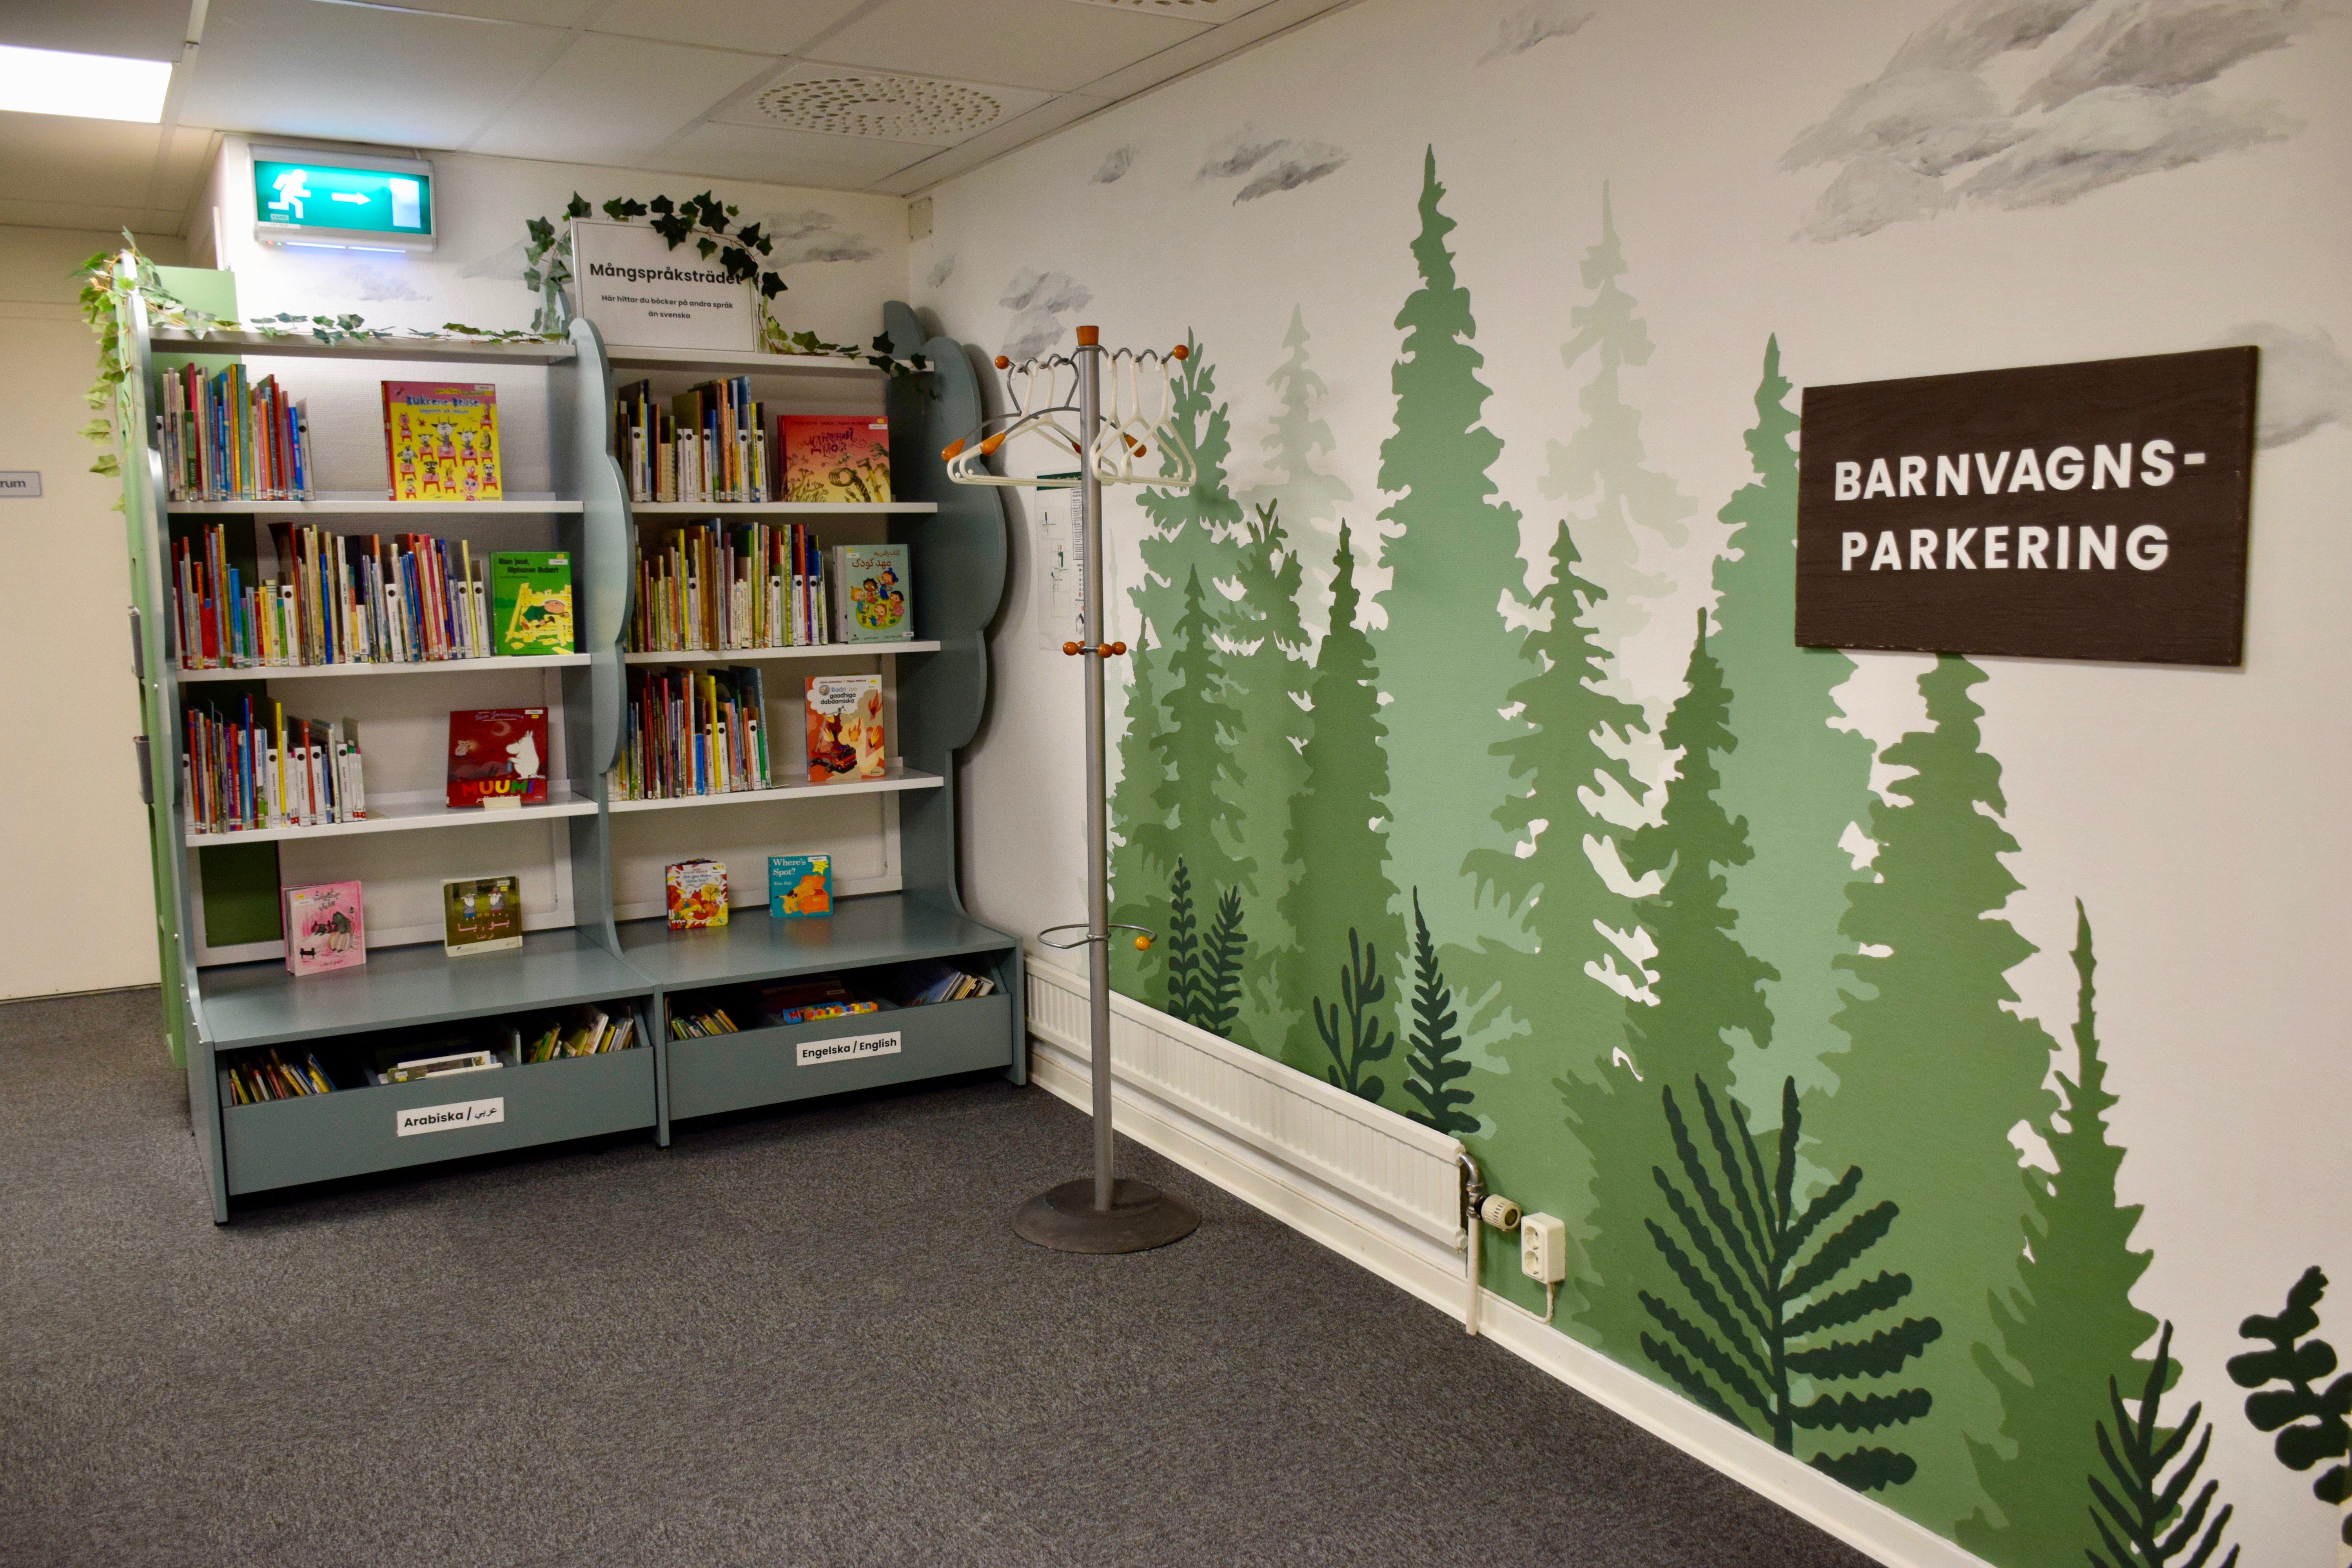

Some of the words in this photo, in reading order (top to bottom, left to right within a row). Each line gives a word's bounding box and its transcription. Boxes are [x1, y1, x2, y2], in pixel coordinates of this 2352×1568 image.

[590, 262, 741, 285] Mångspråksträdet
[651, 298, 676, 306] böcker
[679, 298, 688, 307] på
[713, 300, 733, 310] språk
[1834, 439, 2206, 501] BARNVAGNS-
[1841, 524, 2169, 571] PARKERING
[462, 779, 534, 797] MUUMI
[773, 868, 795, 877] Spot?
[802, 1045, 851, 1059] Engelska
[853, 1041, 857, 1053] /
[860, 1038, 897, 1051] English
[404, 1112, 463, 1127] Arabiska
[467, 1107, 472, 1121] /
[475, 1107, 497, 1120] عربي
